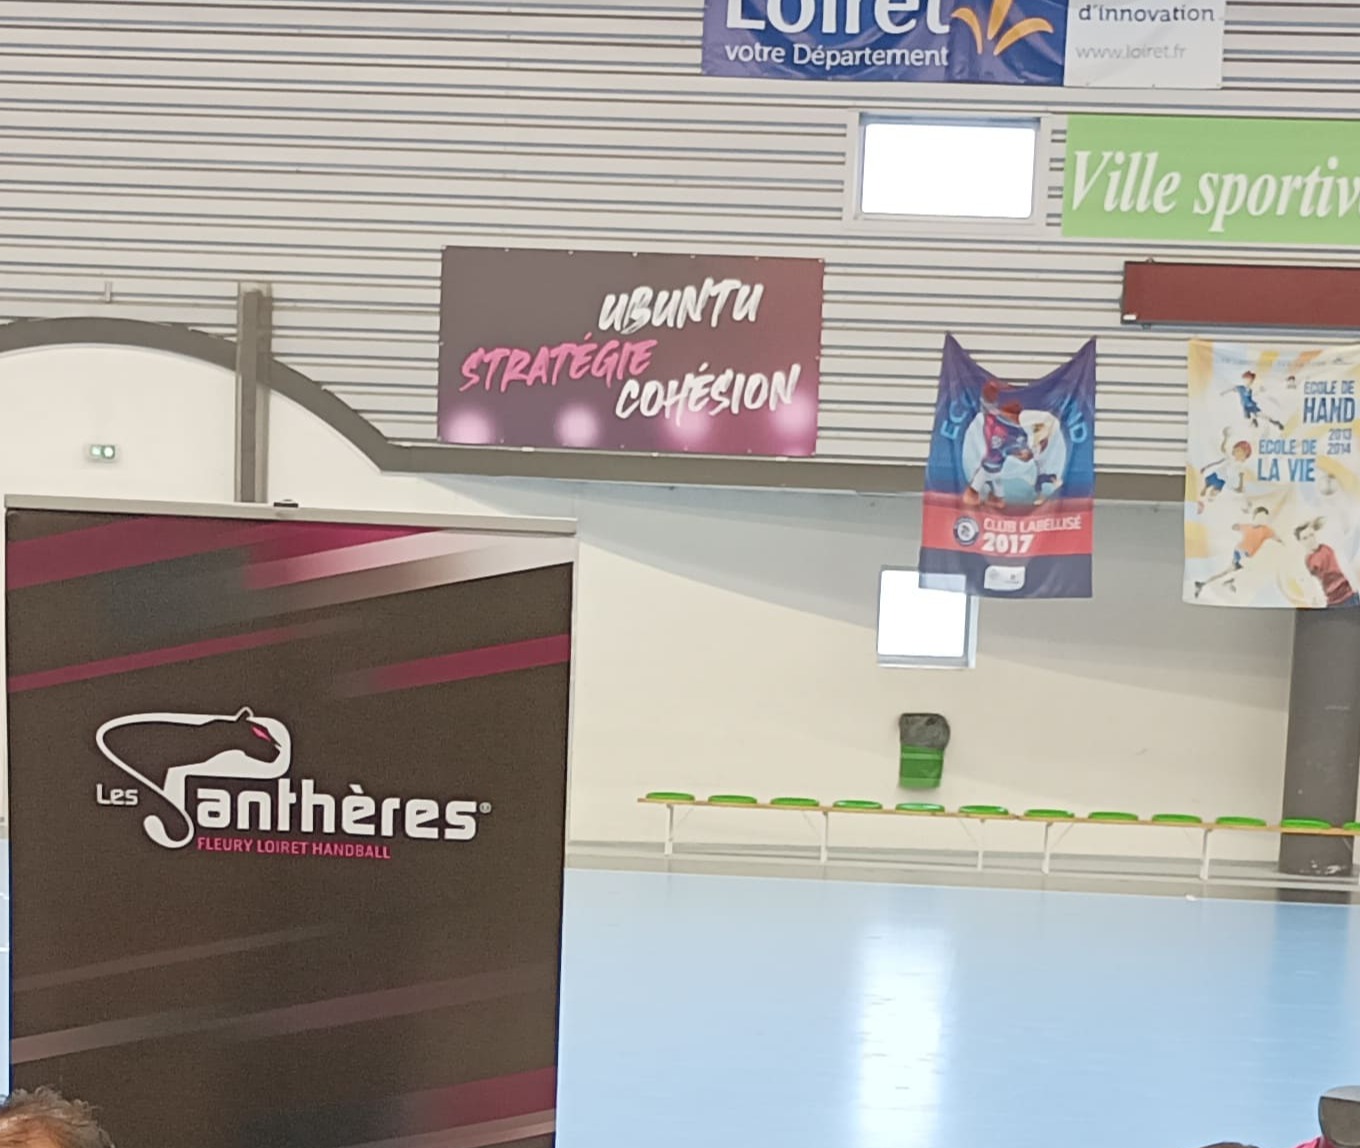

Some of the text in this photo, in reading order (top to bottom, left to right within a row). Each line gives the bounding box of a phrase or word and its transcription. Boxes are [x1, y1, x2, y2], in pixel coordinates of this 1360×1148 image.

[725, 42, 950, 70] votre Département
[1071, 150, 1182, 214] Ville
[598, 276, 765, 336] UBUNTU
[458, 332, 659, 393] STRATÉGIE
[614, 362, 802, 427] COHÉSION
[1302, 397, 1356, 424] HAND
[1257, 458, 1316, 482] LA VIE
[981, 532, 1035, 554] 2017
[96, 783, 139, 806] Les
[197, 836, 392, 860] FLEURY LOIRET HANDBALL
